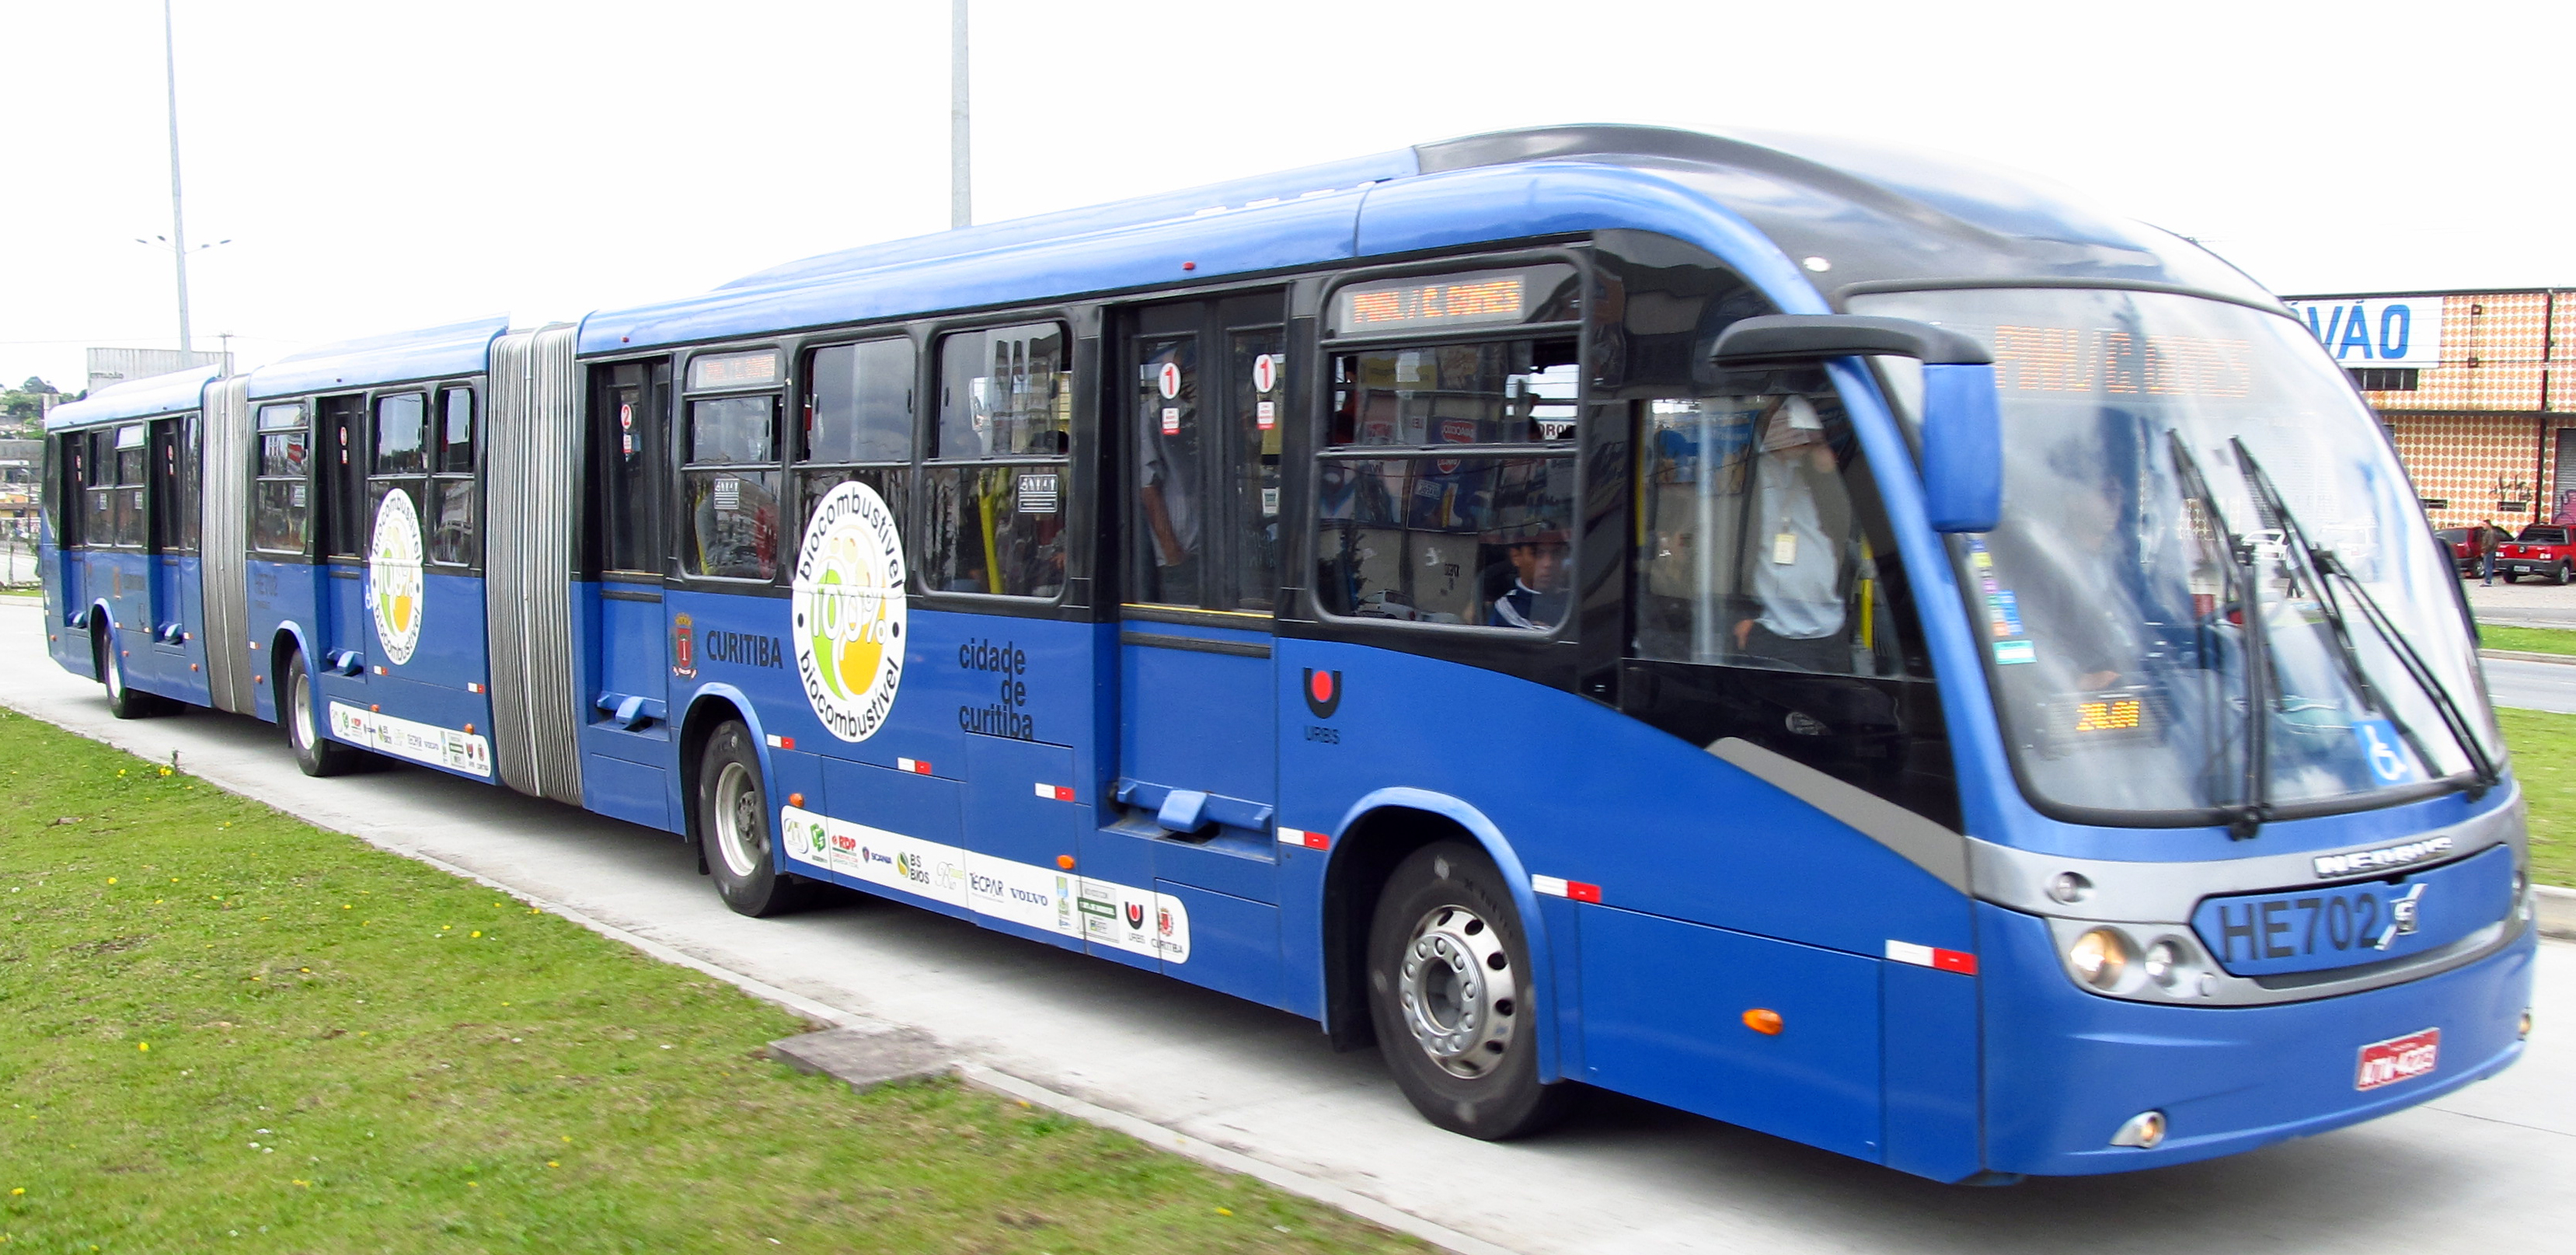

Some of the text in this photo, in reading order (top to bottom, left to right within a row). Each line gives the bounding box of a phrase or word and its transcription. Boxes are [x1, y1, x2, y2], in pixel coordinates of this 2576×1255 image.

[2290, 300, 2410, 359] VÃO
[1165, 367, 1174, 395] 1
[1260, 359, 1271, 389] 1
[623, 406, 630, 426] 2
[800, 487, 904, 588] biocombustível
[811, 583, 887, 646] 100%
[706, 630, 783, 669] CURITIBA
[960, 637, 1026, 675] cidade
[800, 650, 899, 737] biocombustível
[1002, 679, 1026, 706] de
[960, 702, 1034, 741] curitiba
[1305, 725, 1341, 745] URBS
[839, 835, 856, 851] RDP
[871, 852, 892, 864] SCANIA
[910, 854, 922, 868] BS
[910, 868, 929, 884] BIOS
[970, 873, 1004, 896] TECPAR
[1010, 888, 1048, 906] VOLVO
[2219, 892, 2379, 964] HE702
